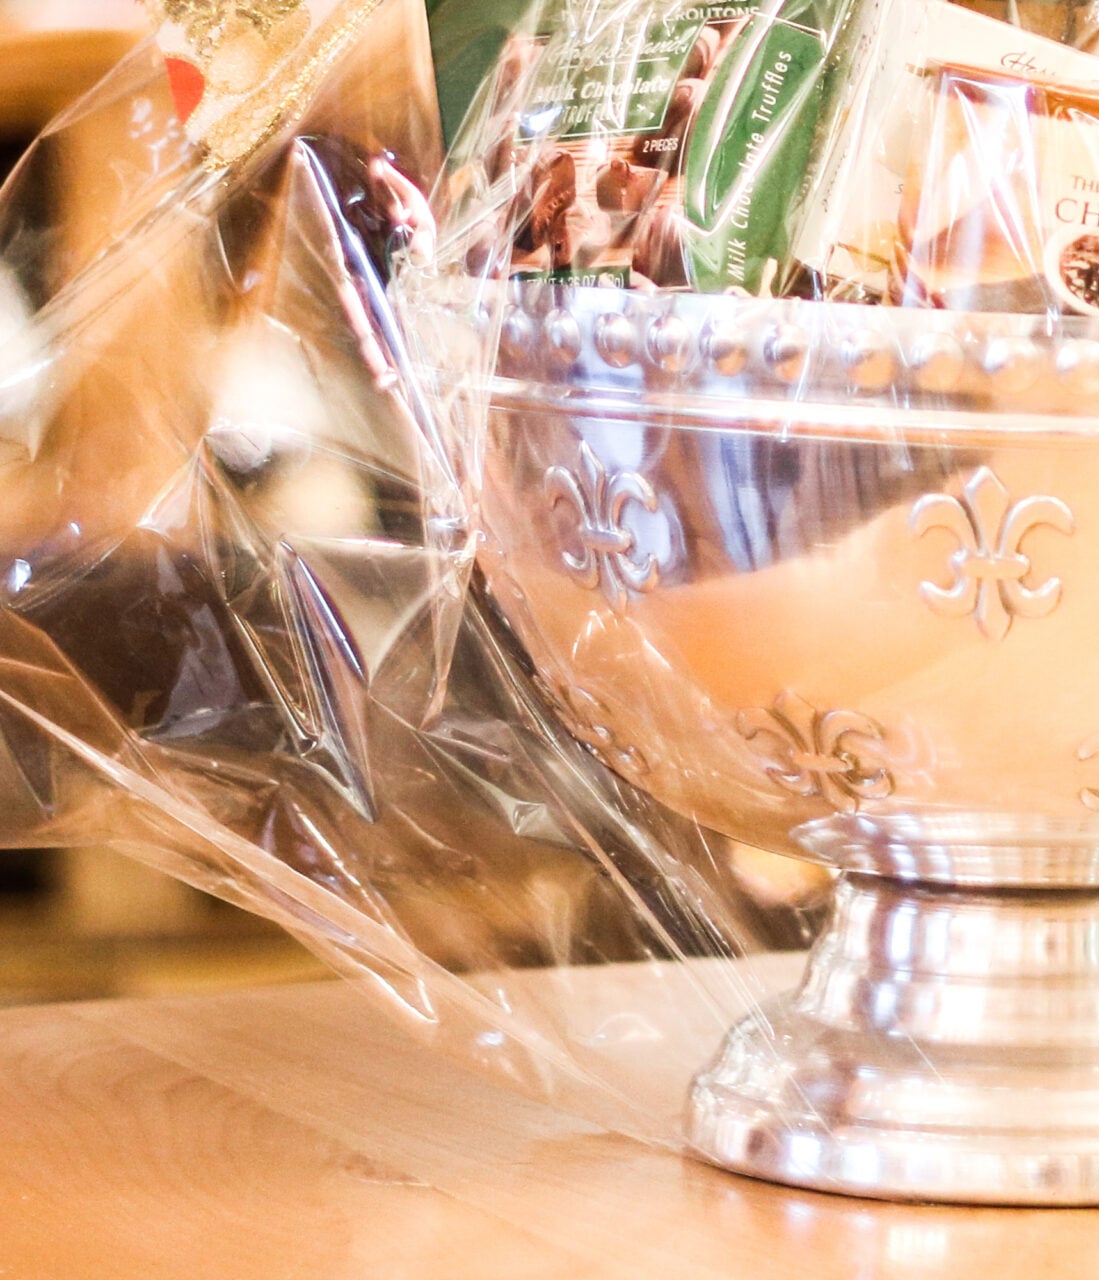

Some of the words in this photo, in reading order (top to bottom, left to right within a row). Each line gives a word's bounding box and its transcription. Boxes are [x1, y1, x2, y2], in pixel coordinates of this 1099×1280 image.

[643, 141, 649, 153] 2
[650, 138, 679, 151] PIECES
[726, 239, 747, 281] Milk
[752, 50, 792, 123] Truffles
